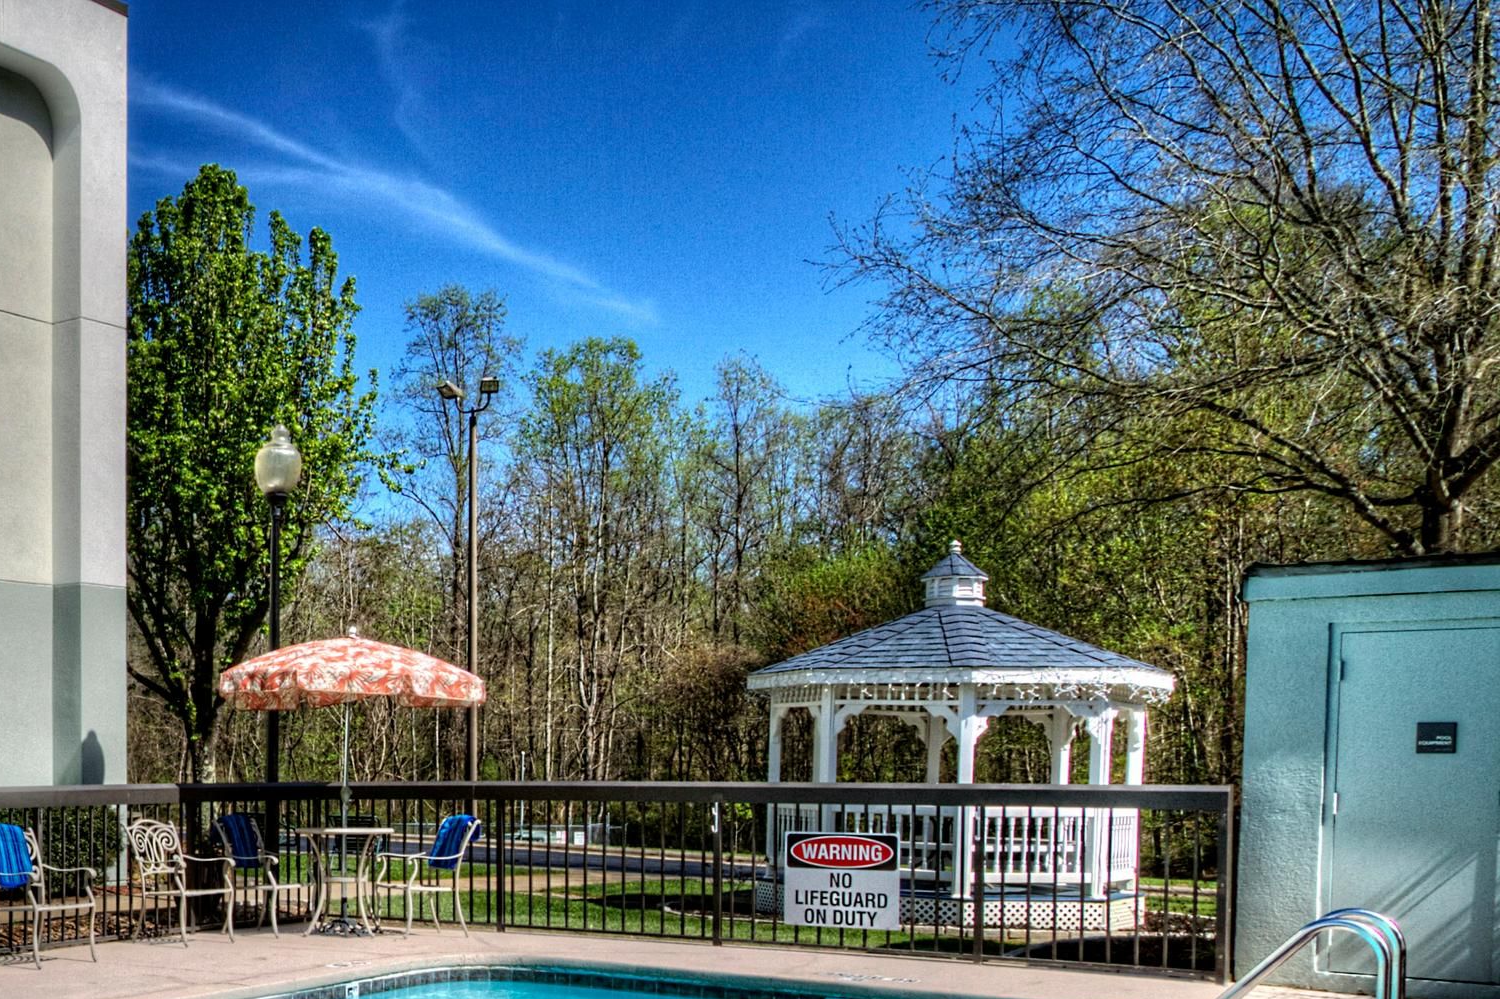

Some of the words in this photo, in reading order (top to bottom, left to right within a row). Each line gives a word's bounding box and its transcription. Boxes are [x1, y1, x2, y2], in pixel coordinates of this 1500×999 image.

[801, 843, 883, 862] WARNING
[829, 872, 853, 889] NO
[794, 889, 888, 909] LIFEGUARD
[804, 908, 827, 925] ON
[833, 910, 878, 927] DUTY
